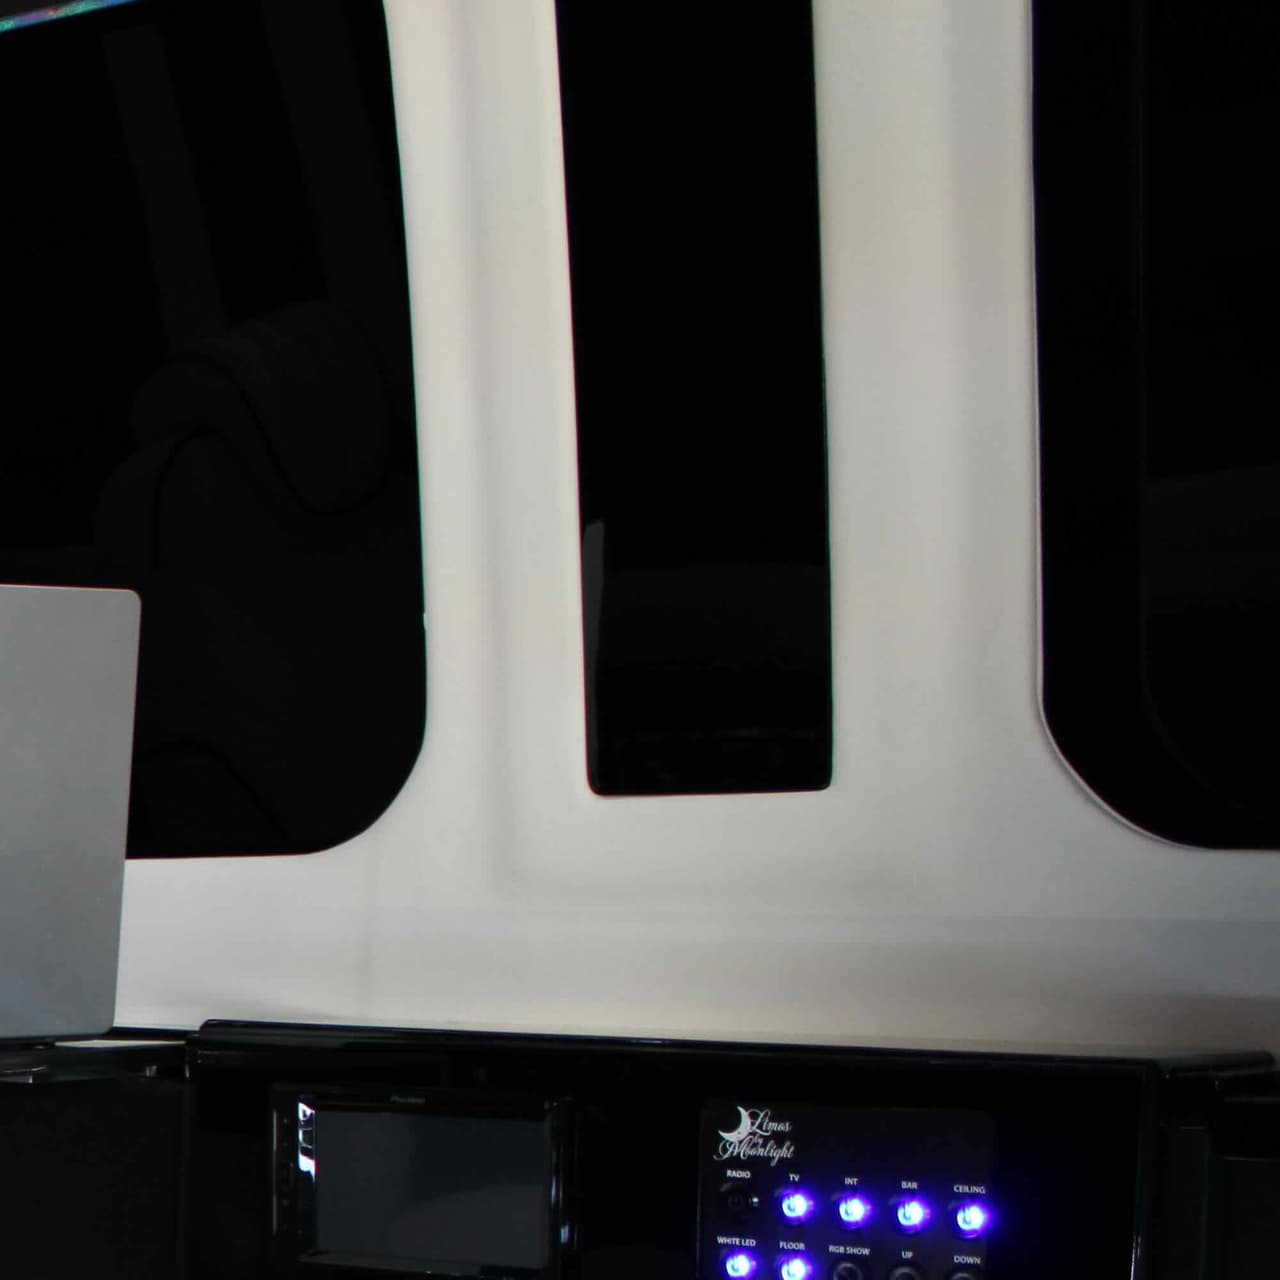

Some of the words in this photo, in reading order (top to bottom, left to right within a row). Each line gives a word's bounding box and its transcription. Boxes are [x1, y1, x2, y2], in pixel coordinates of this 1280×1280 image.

[748, 1108, 792, 1136] Limos
[713, 1137, 796, 1167] Moonlight
[726, 1169, 752, 1179] RADIO
[789, 1173, 800, 1182] TV
[844, 1177, 859, 1186] INT
[901, 1180, 918, 1190] BAR
[953, 1184, 987, 1195] CEILING
[716, 1235, 740, 1246] WHITE
[741, 1238, 757, 1248] LED
[779, 1240, 806, 1251] FLOOR
[845, 1246, 871, 1256] SHOW
[901, 1250, 914, 1260] UP
[953, 1255, 982, 1265] DOWN
